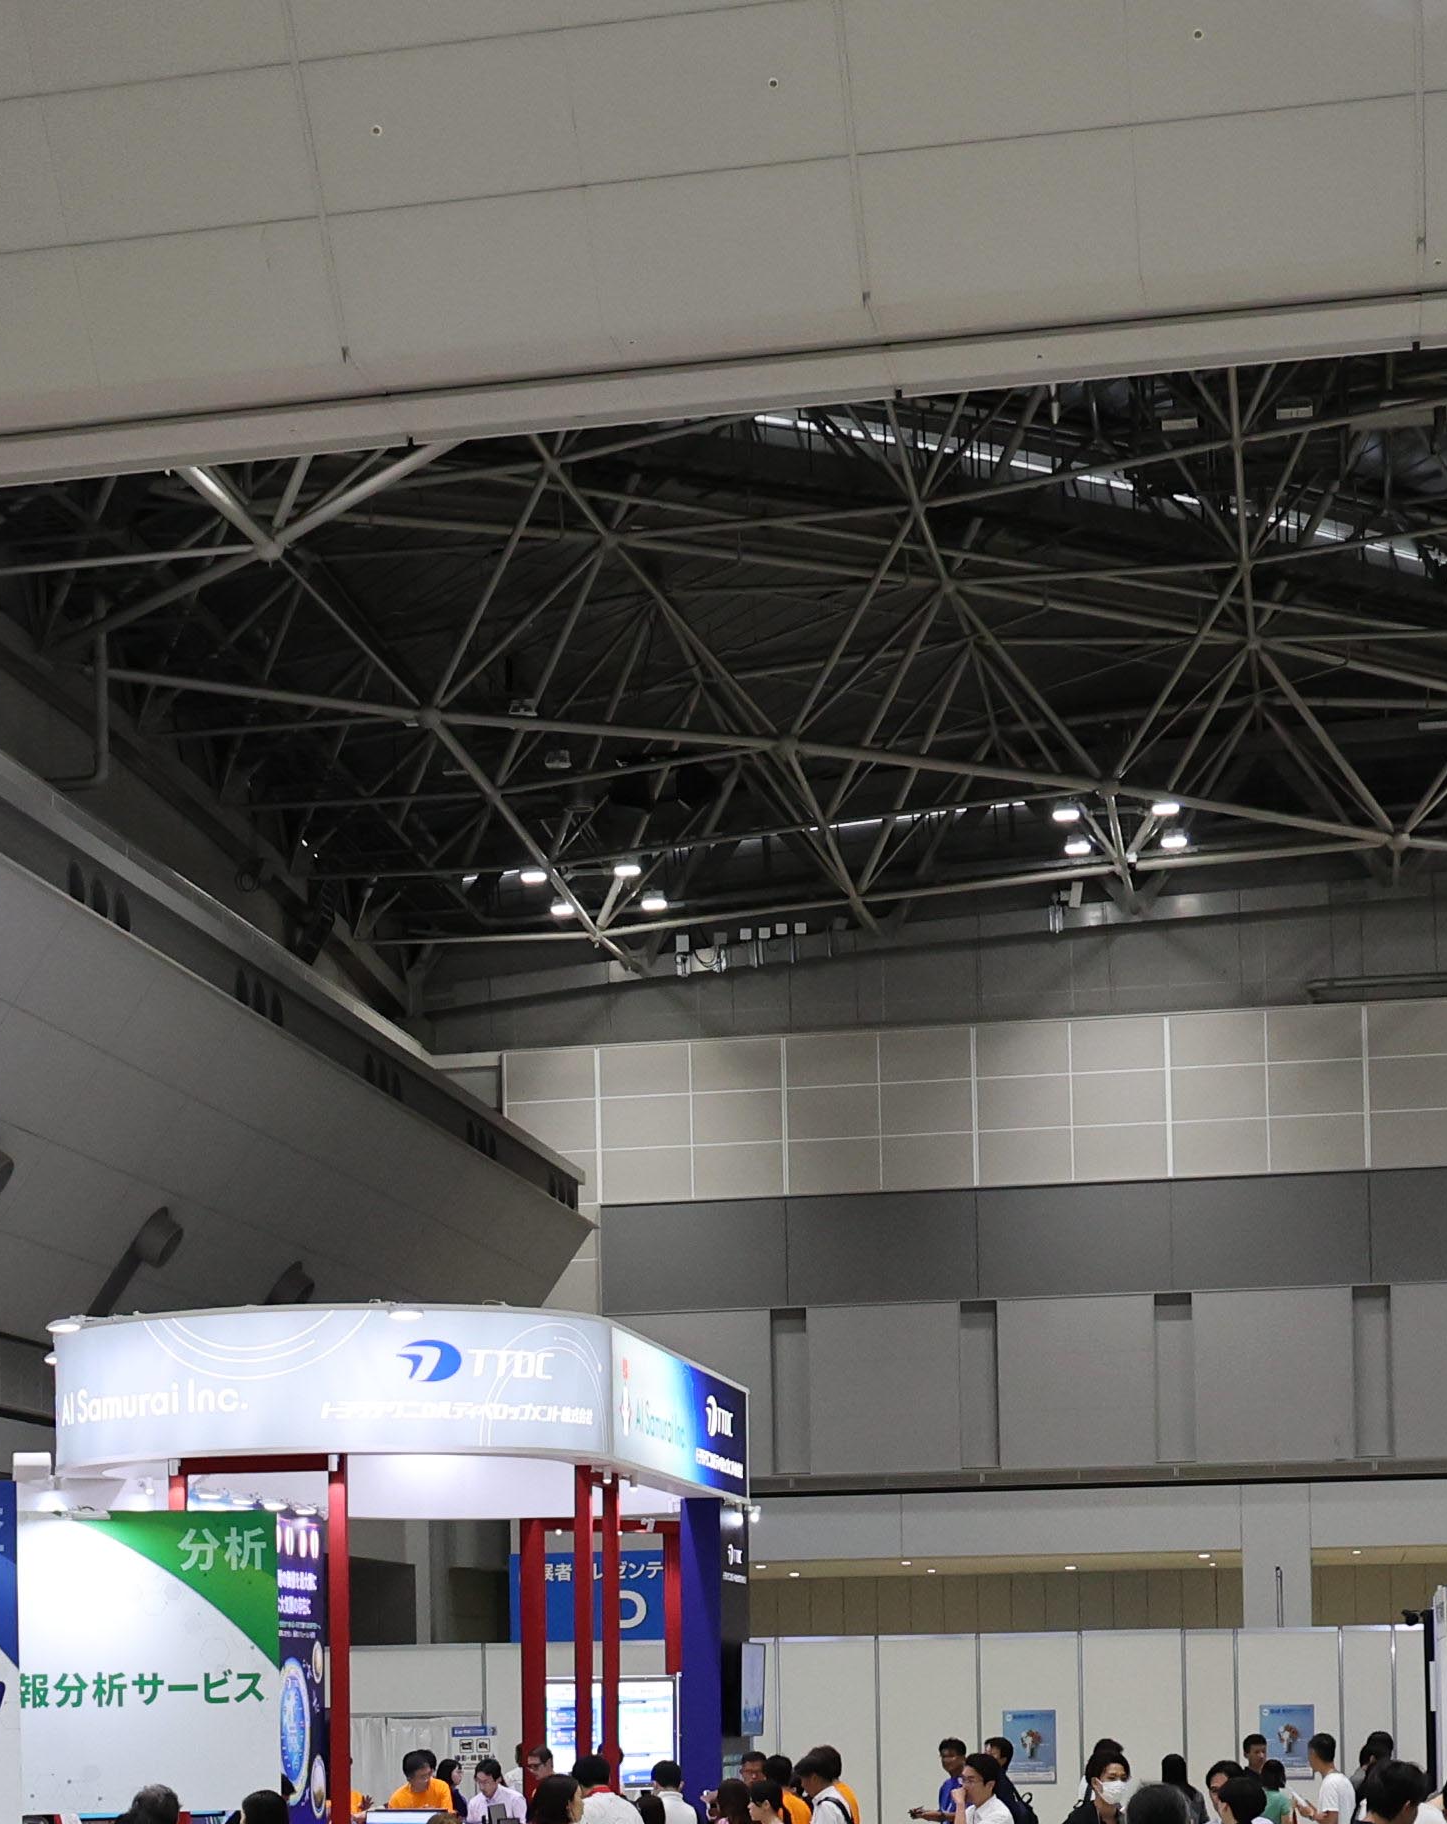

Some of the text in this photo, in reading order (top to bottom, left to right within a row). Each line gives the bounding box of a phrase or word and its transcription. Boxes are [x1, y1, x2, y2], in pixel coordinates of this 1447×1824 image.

[467, 1350, 555, 1379] TTDC
[77, 1382, 179, 1423] Samurai
[188, 1379, 248, 1412] Inc.
[177, 1526, 267, 1572] 分析
